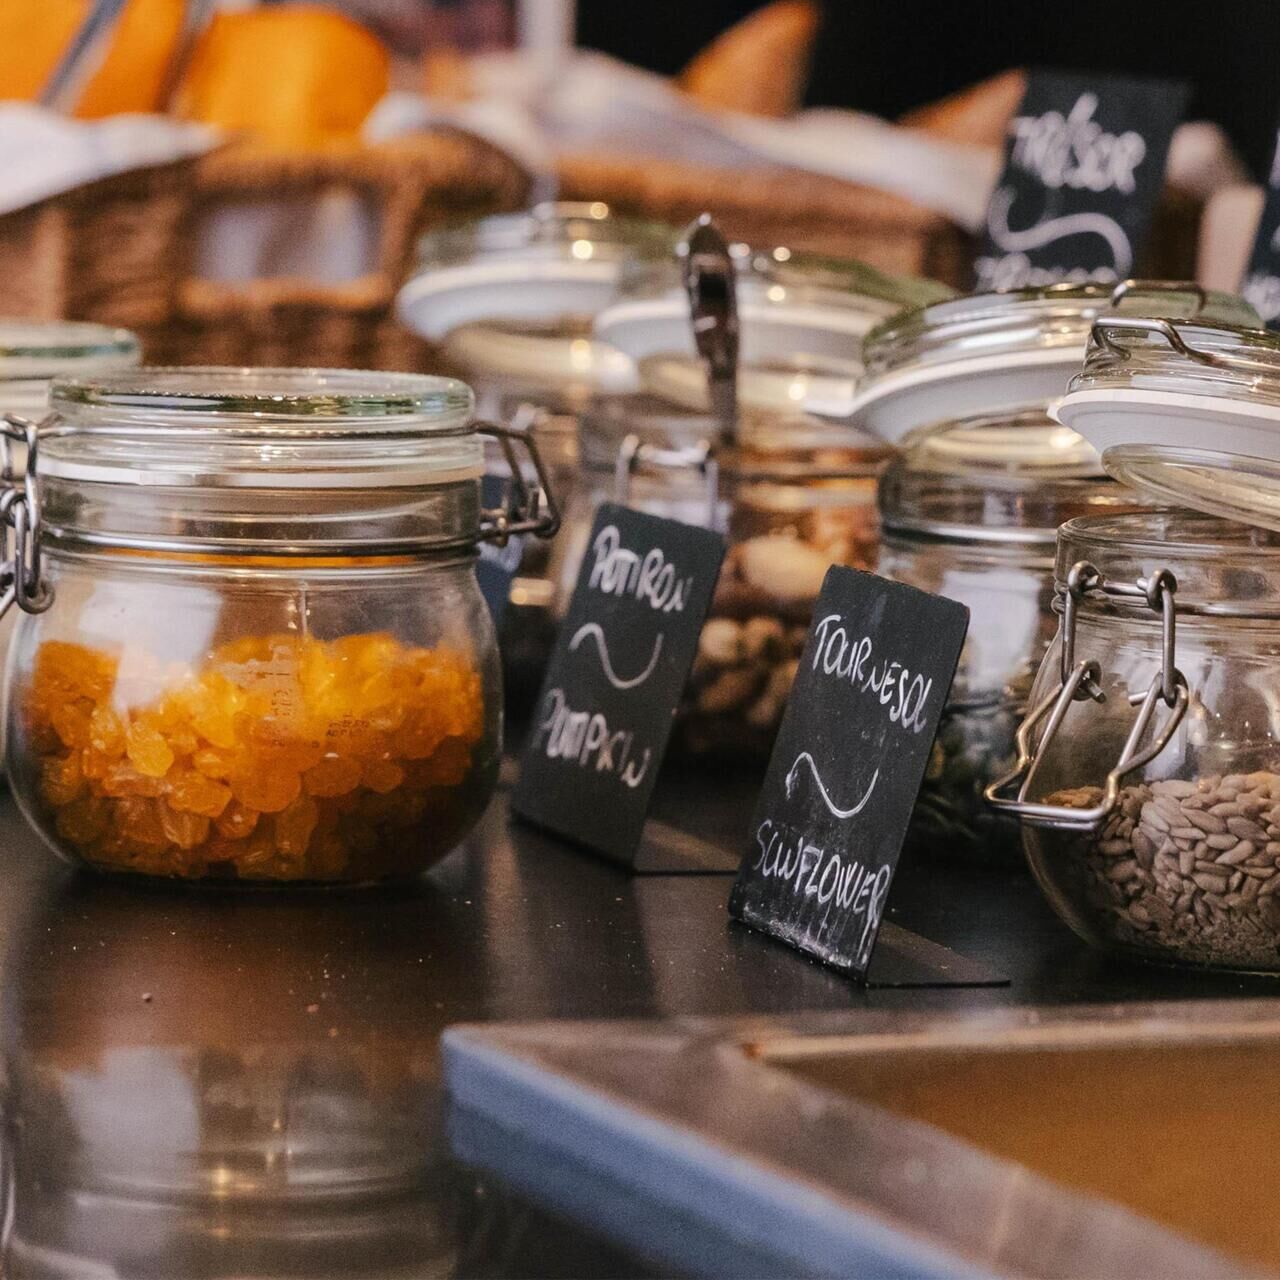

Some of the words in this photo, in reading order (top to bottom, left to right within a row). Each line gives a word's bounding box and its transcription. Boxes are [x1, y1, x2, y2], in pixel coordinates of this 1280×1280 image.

[588, 524, 694, 612] POTIRON
[813, 614, 933, 734] TOURNESOL
[753, 819, 891, 930] SUNFLOWER
